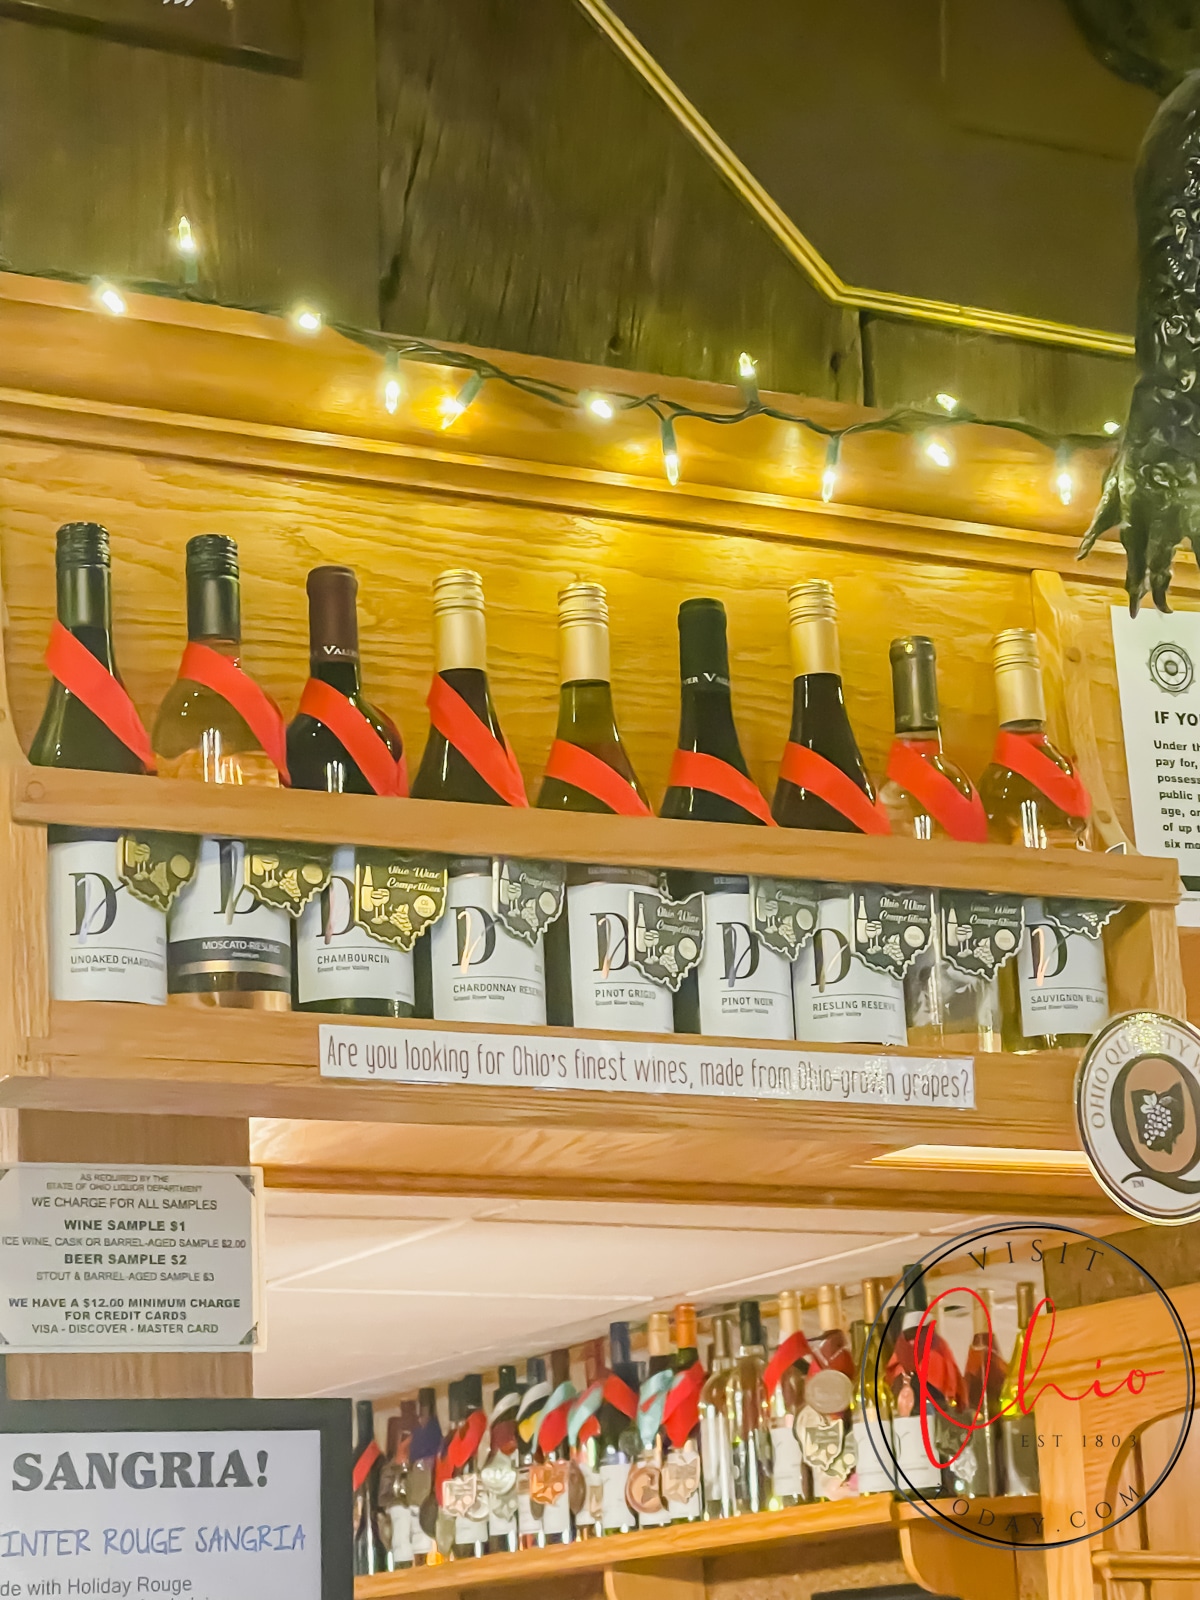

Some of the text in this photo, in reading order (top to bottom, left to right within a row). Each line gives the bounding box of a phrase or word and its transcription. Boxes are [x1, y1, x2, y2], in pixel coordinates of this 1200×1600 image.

[1155, 711, 1200, 726] IF YO
[1153, 740, 1187, 750] Under
[1155, 758, 1198, 769] pay for,
[1159, 790, 1193, 801] public
[1161, 807, 1185, 818] age,
[1162, 822, 1173, 831] of
[1178, 825, 1192, 834] up
[1164, 839, 1181, 848] six
[387, 876, 441, 893] Competition
[880, 896, 927, 911] Ohio Wine
[879, 909, 930, 924] Competition
[969, 914, 1019, 928] Competition
[70, 955, 119, 965] UNOAKED
[317, 953, 390, 965] CHAMBOURCIN
[453, 983, 516, 994] CHARDONNAY
[595, 988, 625, 998] PINOT
[721, 997, 751, 1006] PINOT
[1030, 994, 1084, 1004] SAUVIGNON
[812, 1000, 859, 1012] RIESLING
[327, 1035, 970, 1102] Are you looking for Ohio's finest wines, made from Ohio-grown grapes?
[1091, 1030, 1191, 1130] OHIO QUTY
[80, 1173, 169, 1183] AS REQUIRED BY THE
[76, 1182, 88, 1190] OF
[90, 1182, 111, 1190] OHIO
[113, 1183, 145, 1191] LIQUOR
[147, 1184, 203, 1192] DEPARTMENT
[31, 1197, 217, 1210] WE CHARGE FOR ALL SAMPLES
[64, 1219, 186, 1232] WINE SAMPLE $1
[1, 1236, 247, 1249] ICE WINE, CASK OR BARREL-AGED SAMPLE $2.00
[64, 1253, 188, 1265] BEER SAMPLE $2
[36, 1271, 215, 1282] STOUT & BARREL-AGED SAMPLE $3
[8, 1298, 241, 1308] WE HAVE A $12.00 MINIMUM CHARGE
[65, 1311, 187, 1321] FOR CREDIT CARDS
[31, 1324, 59, 1334] VISA
[69, 1324, 127, 1334] DISCOVER
[137, 1324, 184, 1334] MASTER
[187, 1324, 219, 1334] CARD
[12, 1449, 269, 1491] SANGRIA!
[103, 1526, 187, 1555] ROUGE
[195, 1524, 306, 1554] SANGRIA
[27, 1579, 62, 1596] with
[67, 1578, 133, 1597] Holiday
[137, 1576, 193, 1596] Rouge
